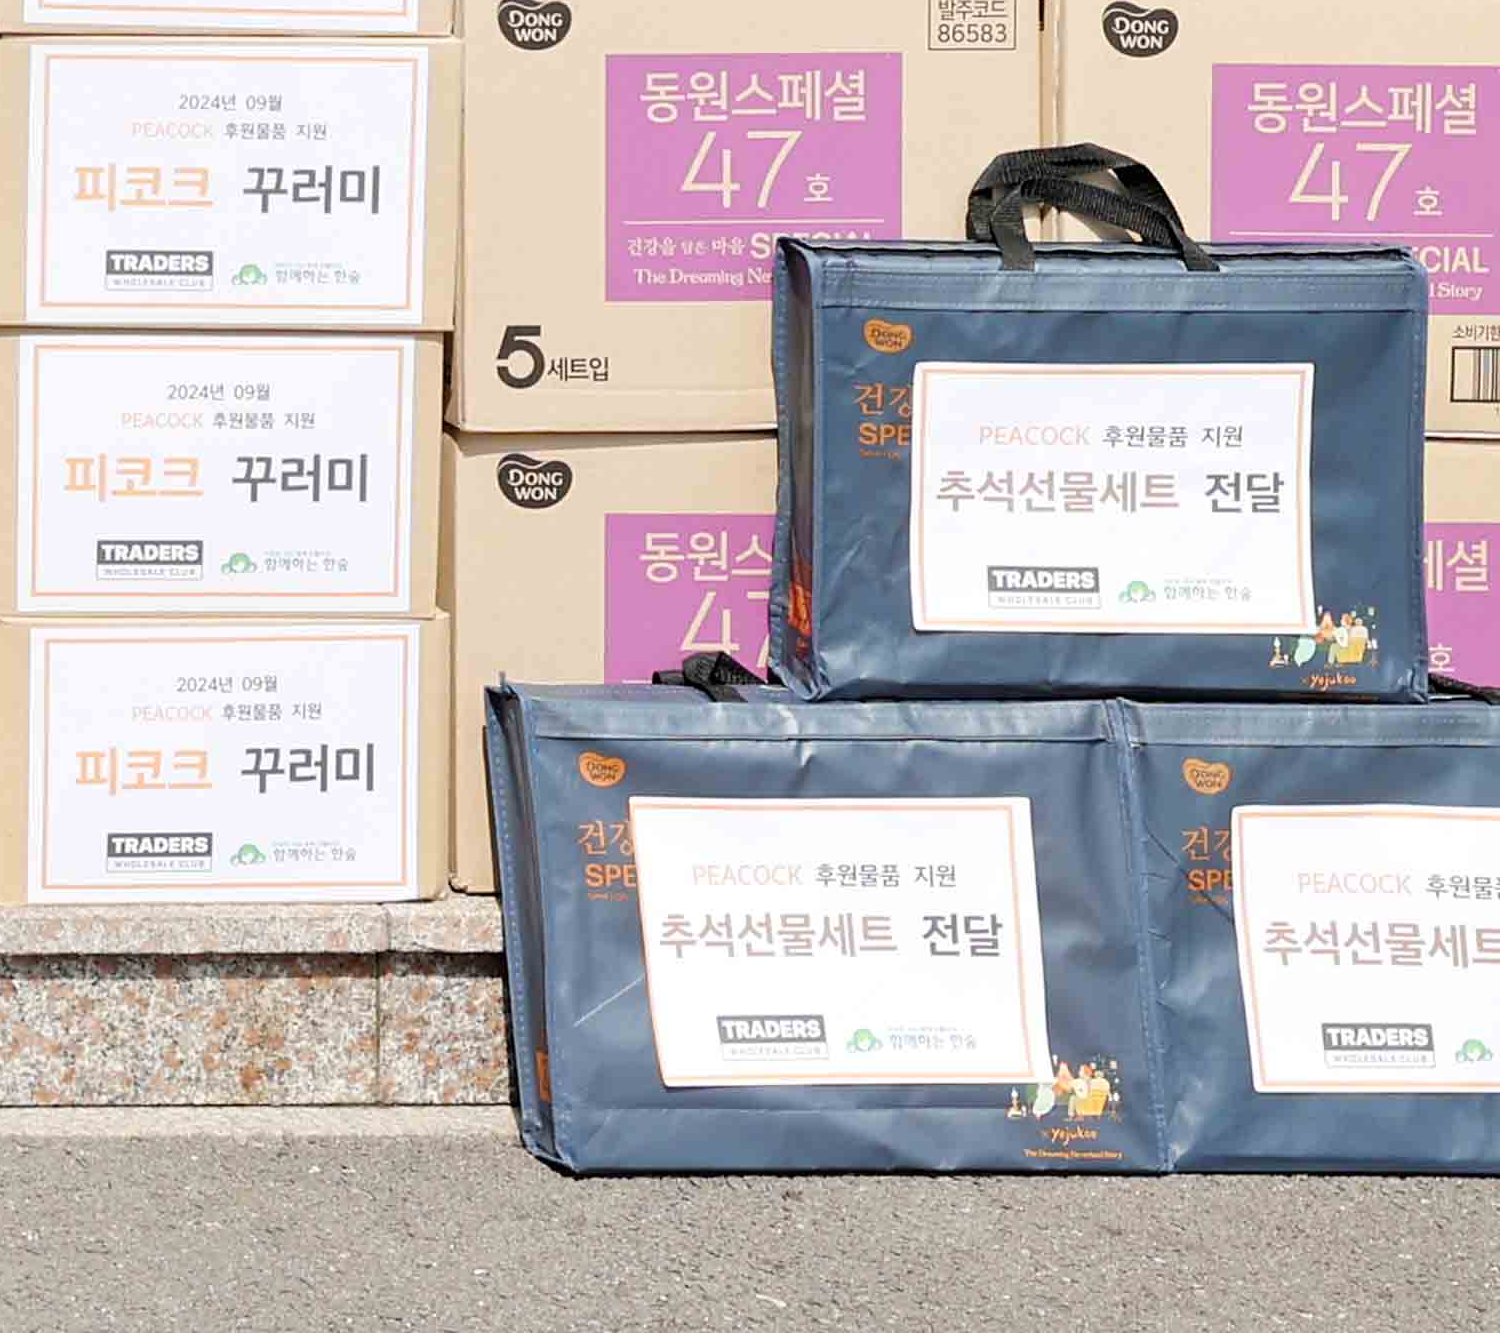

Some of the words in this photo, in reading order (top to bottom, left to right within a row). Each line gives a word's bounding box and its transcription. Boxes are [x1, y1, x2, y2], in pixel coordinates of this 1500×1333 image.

[639, 68, 866, 124] 동원스페셜
[1245, 81, 1477, 135] 동원스페셜
[680, 130, 803, 209] 47
[935, 469, 1180, 514] 추석선물세트
[1204, 471, 1285, 514] 전달
[992, 568, 1096, 591] TRADERS
[659, 912, 898, 959] 추석선물세트
[922, 913, 1004, 958] 전달
[1263, 920, 1500, 969] 추석선물세트
[1325, 1027, 1431, 1048] TRADERS
